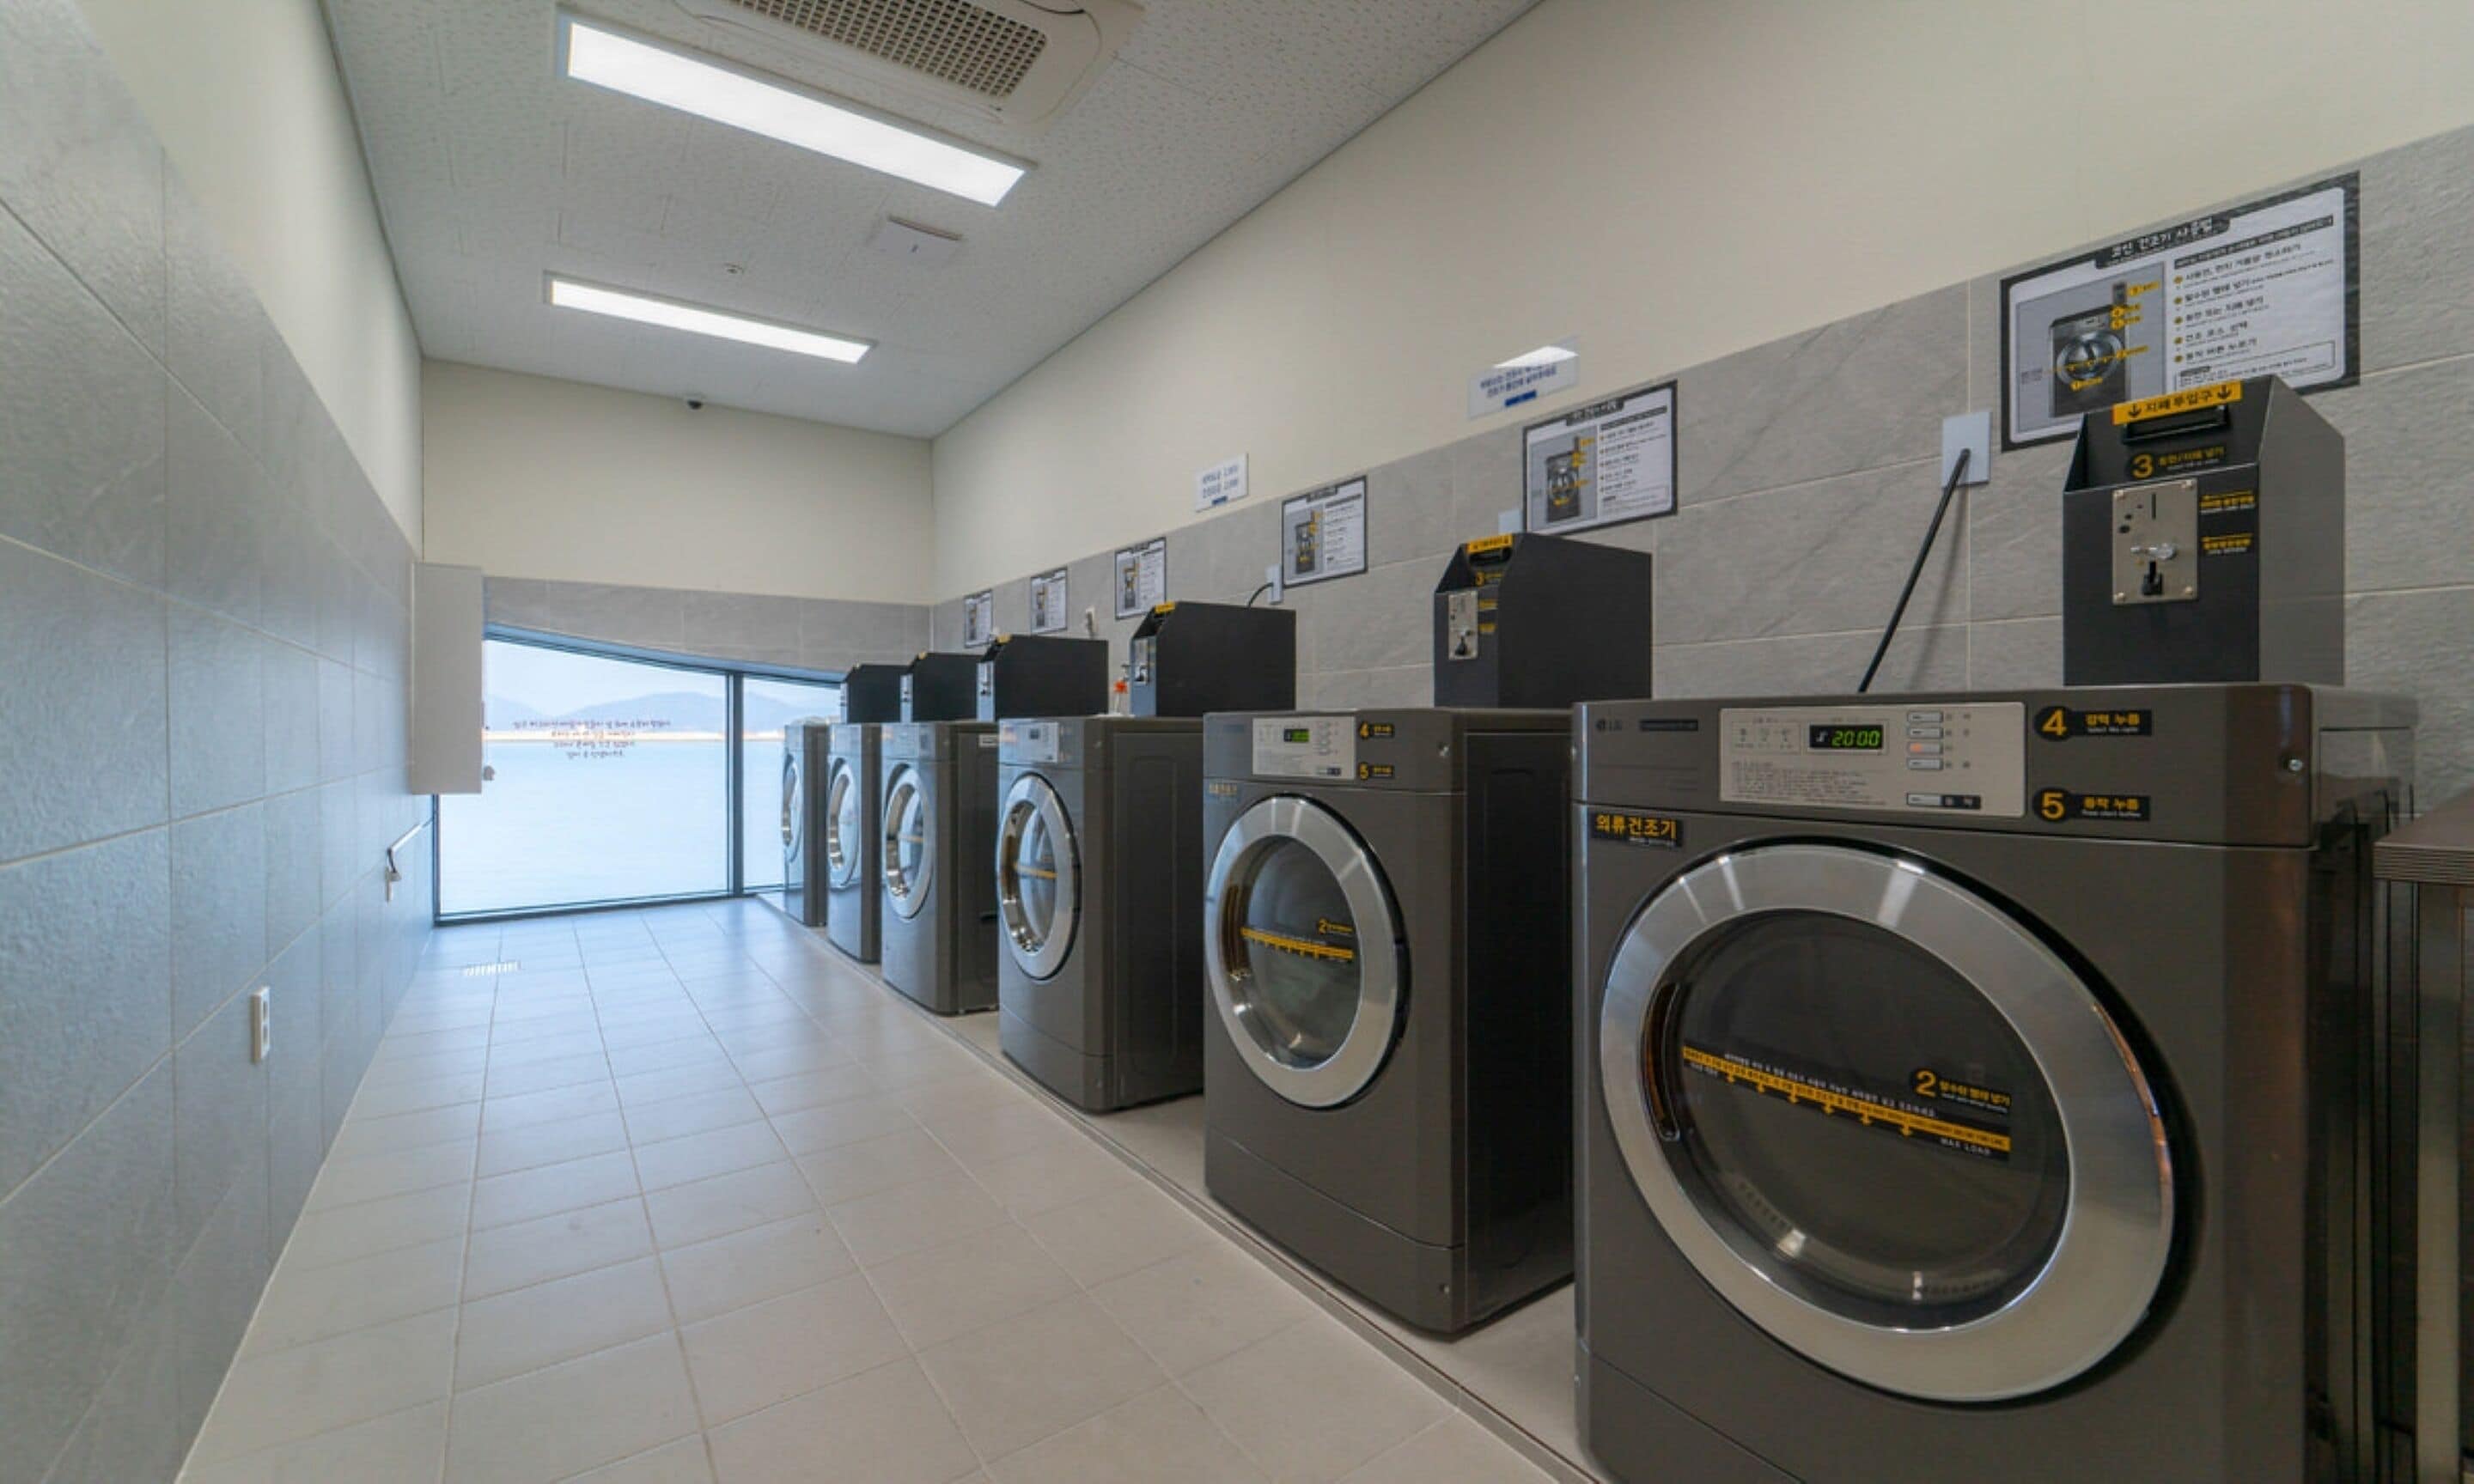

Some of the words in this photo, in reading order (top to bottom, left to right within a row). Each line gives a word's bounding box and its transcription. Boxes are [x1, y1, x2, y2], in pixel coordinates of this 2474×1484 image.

[2146, 398, 2171, 412] 지폐
[2173, 390, 2212, 406] 투입구
[2131, 453, 2154, 479] 3
[2041, 709, 2068, 737] 4
[2041, 792, 2066, 821] 5
[1916, 1069, 1937, 1098] 2
